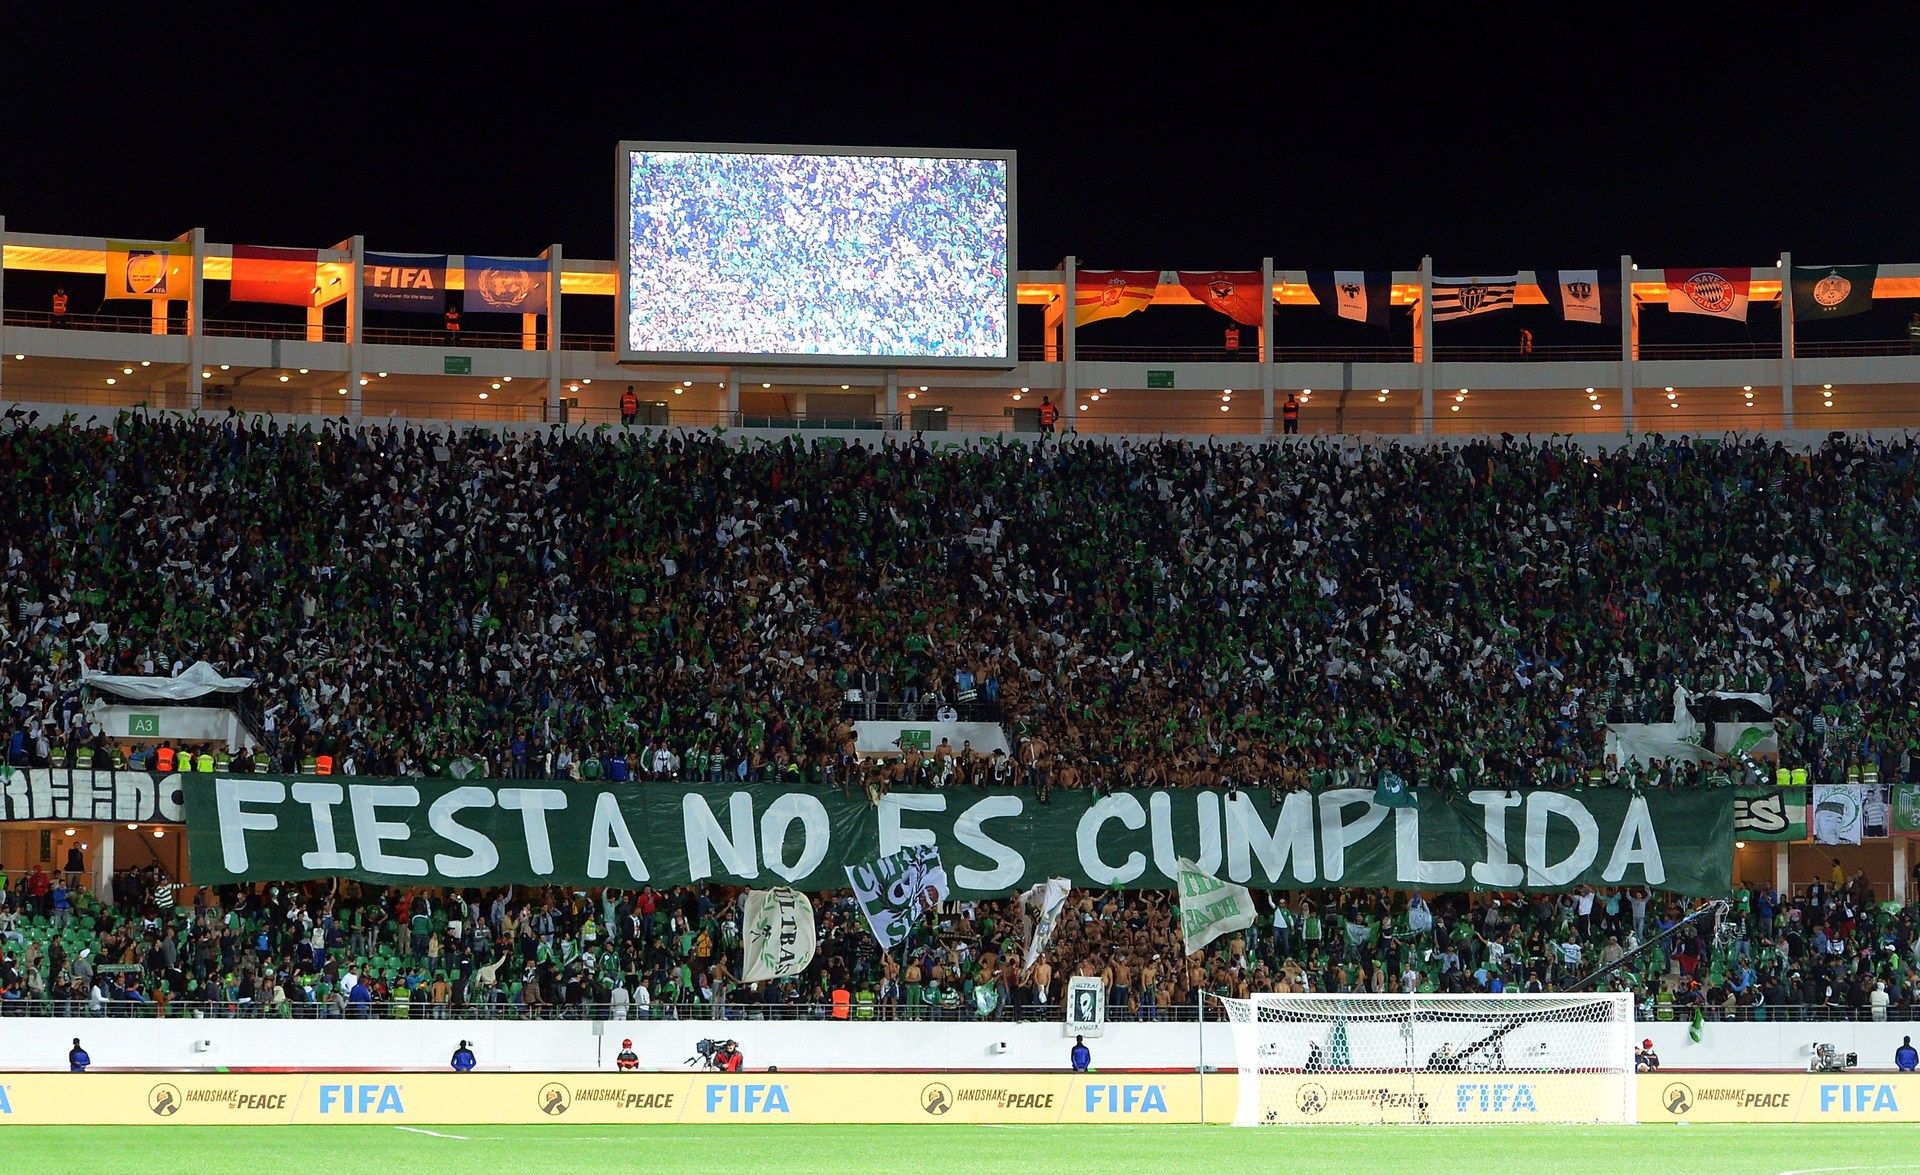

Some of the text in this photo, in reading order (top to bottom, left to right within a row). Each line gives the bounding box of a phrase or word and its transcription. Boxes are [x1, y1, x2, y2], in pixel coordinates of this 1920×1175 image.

[374, 267, 434, 289] FIFA
[1694, 275, 1730, 290] BAYEN
[135, 719, 152, 731] A3
[910, 730, 922, 740] T7
[215, 778, 1666, 890] FIESTA NO ES CUMPLIDA
[774, 887, 797, 975] ULTRAS
[186, 1090, 238, 1102] HANDSHAKE
[237, 1094, 287, 1109] PEACE
[319, 1085, 404, 1114] FIFA
[575, 1089, 627, 1101] HANDSHAKE
[625, 1094, 674, 1108] PEACE
[706, 1084, 790, 1113] FIFA
[957, 1089, 1008, 1101] HANDSHAKE
[1006, 1094, 1054, 1108] PEACE
[1085, 1085, 1168, 1113] FIFA
[1457, 1084, 1538, 1112] FIFA
[1697, 1088, 1746, 1100] HANDSHAKE
[1744, 1093, 1790, 1108] PEACE
[1820, 1084, 1898, 1112] FIFA
